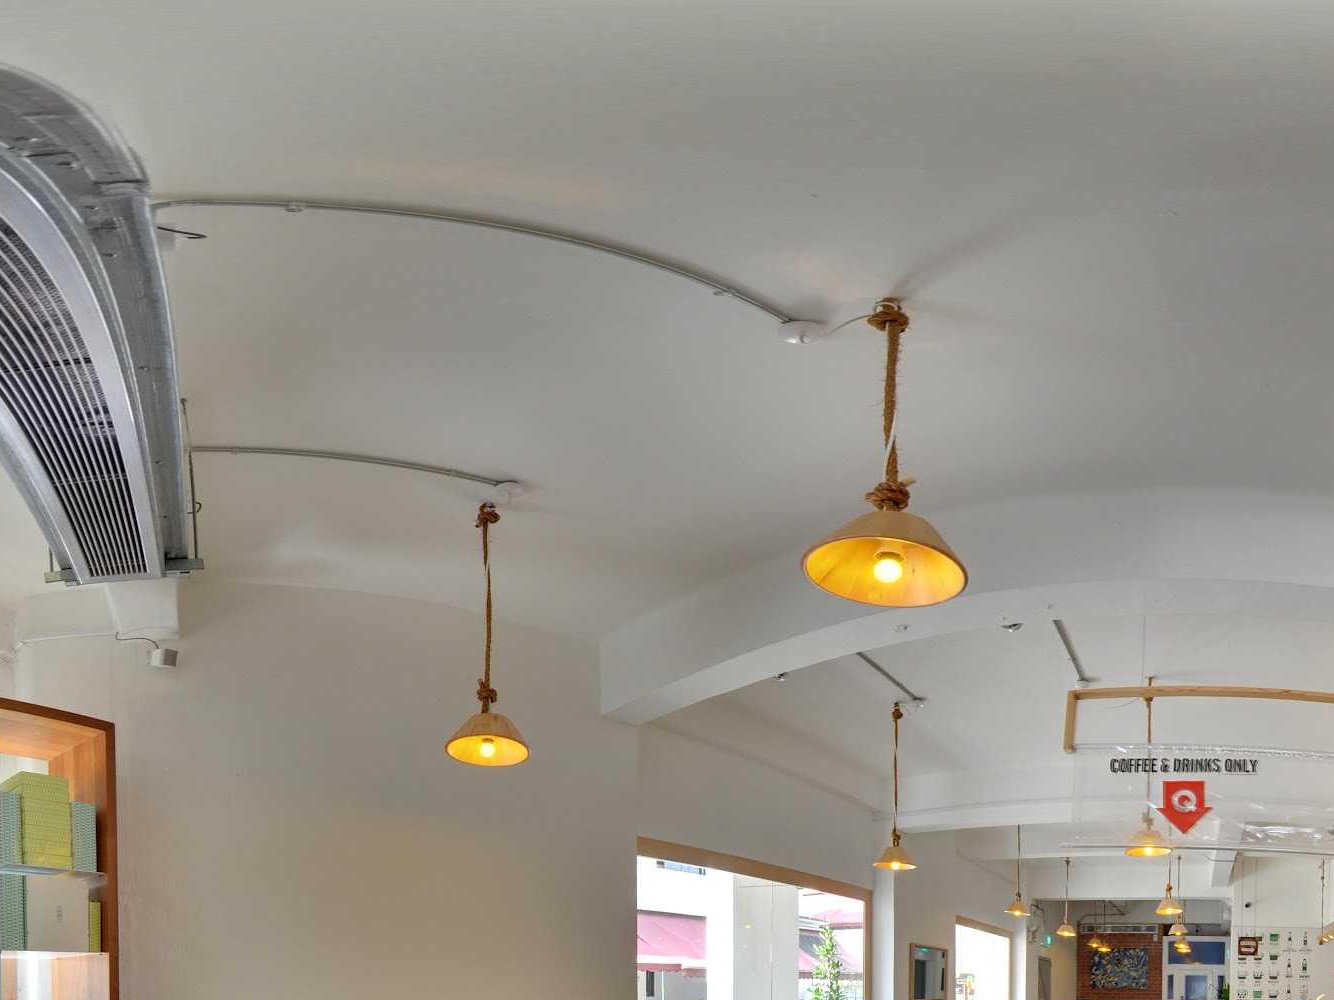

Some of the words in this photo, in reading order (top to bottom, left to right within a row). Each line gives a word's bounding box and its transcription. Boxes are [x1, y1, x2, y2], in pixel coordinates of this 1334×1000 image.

[1110, 758, 1157, 773] COFFEE
[1160, 758, 1169, 773] &
[1173, 758, 1221, 773] DRINKS
[1225, 758, 1258, 773] ONLY
[1171, 789, 1198, 812] Q
